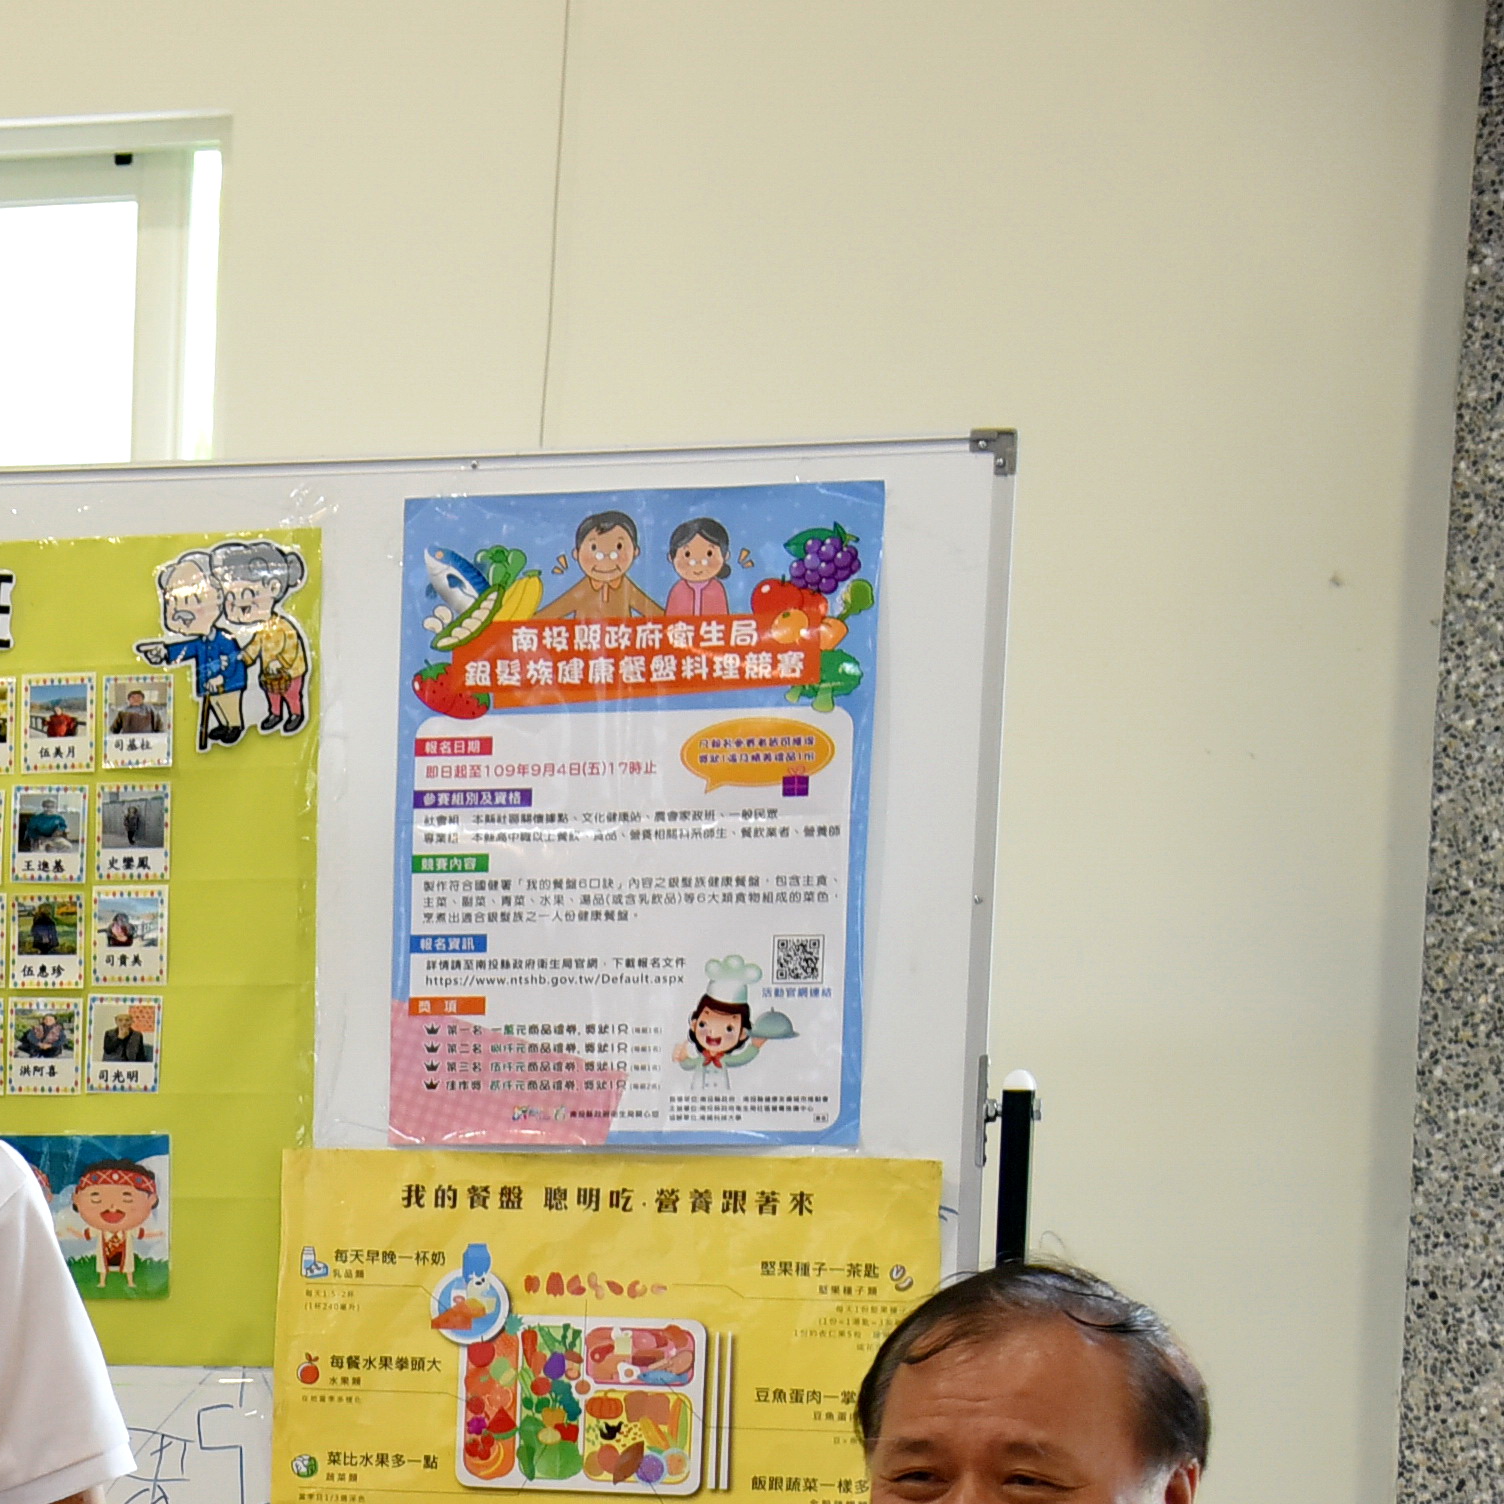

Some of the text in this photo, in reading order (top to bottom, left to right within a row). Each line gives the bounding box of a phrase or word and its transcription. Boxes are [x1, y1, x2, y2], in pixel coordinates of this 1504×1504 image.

[511, 619, 758, 653] 南投縣政府衛生局
[465, 651, 806, 688] 銀髮族健康餐盤料理競賽
[40, 746, 76, 759] 伍美月
[425, 740, 481, 753] 報名日期
[425, 761, 657, 779] 即日起至109年9月4日(五)17時止
[423, 791, 521, 806] 參賽組別及資格
[421, 857, 477, 871] 競賽內容
[420, 937, 475, 951] 報名資訊
[22, 963, 65, 978] 伍惠珍
[425, 973, 684, 987] https://www.ntshb.gov.tw/Default.aspx
[19, 1065, 58, 1078] 洪阿喜
[98, 1069, 139, 1083] 司光明
[400, 1183, 525, 1211] 我的餐盤
[334, 1248, 446, 1267] 每天早晚一杯奶
[333, 1269, 365, 1279] 乳品類
[761, 1261, 879, 1279] 堅果種子一茶匙
[818, 1285, 878, 1296] 堅果種子類
[330, 1354, 442, 1373] 每餐水果拳頭大
[329, 1376, 361, 1386] 水果類
[813, 1411, 854, 1421] 豆魚蛋
[327, 1450, 438, 1470] 菜比水果多一點
[326, 1472, 358, 1483] 蔬菜類
[751, 1475, 870, 1494] 飯跟蔬菜一樣多
